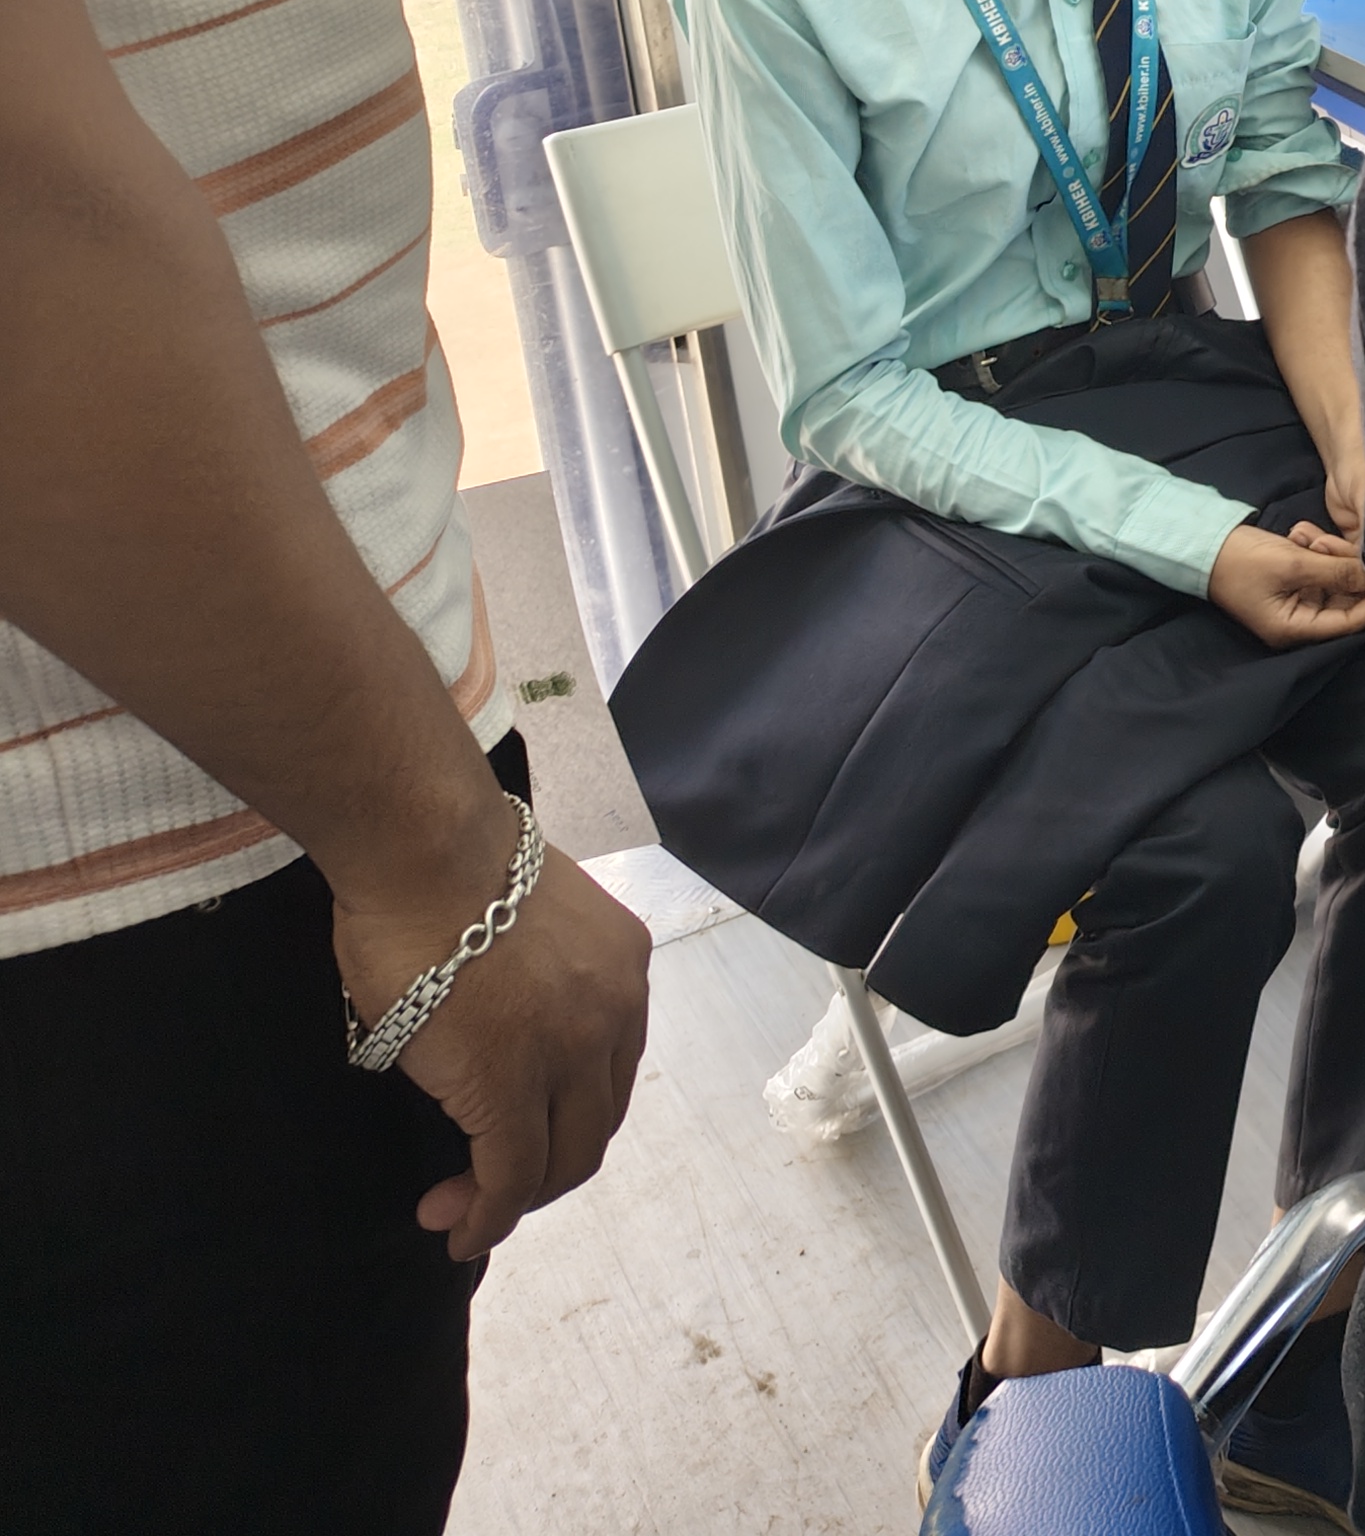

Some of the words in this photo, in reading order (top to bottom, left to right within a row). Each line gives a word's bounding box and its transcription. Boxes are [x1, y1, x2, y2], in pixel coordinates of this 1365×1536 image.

[1023, 82, 1070, 166] www.kbiher.in
[1135, 55, 1151, 144] www.kbiher.in
[1067, 178, 1099, 232] KBIHER
